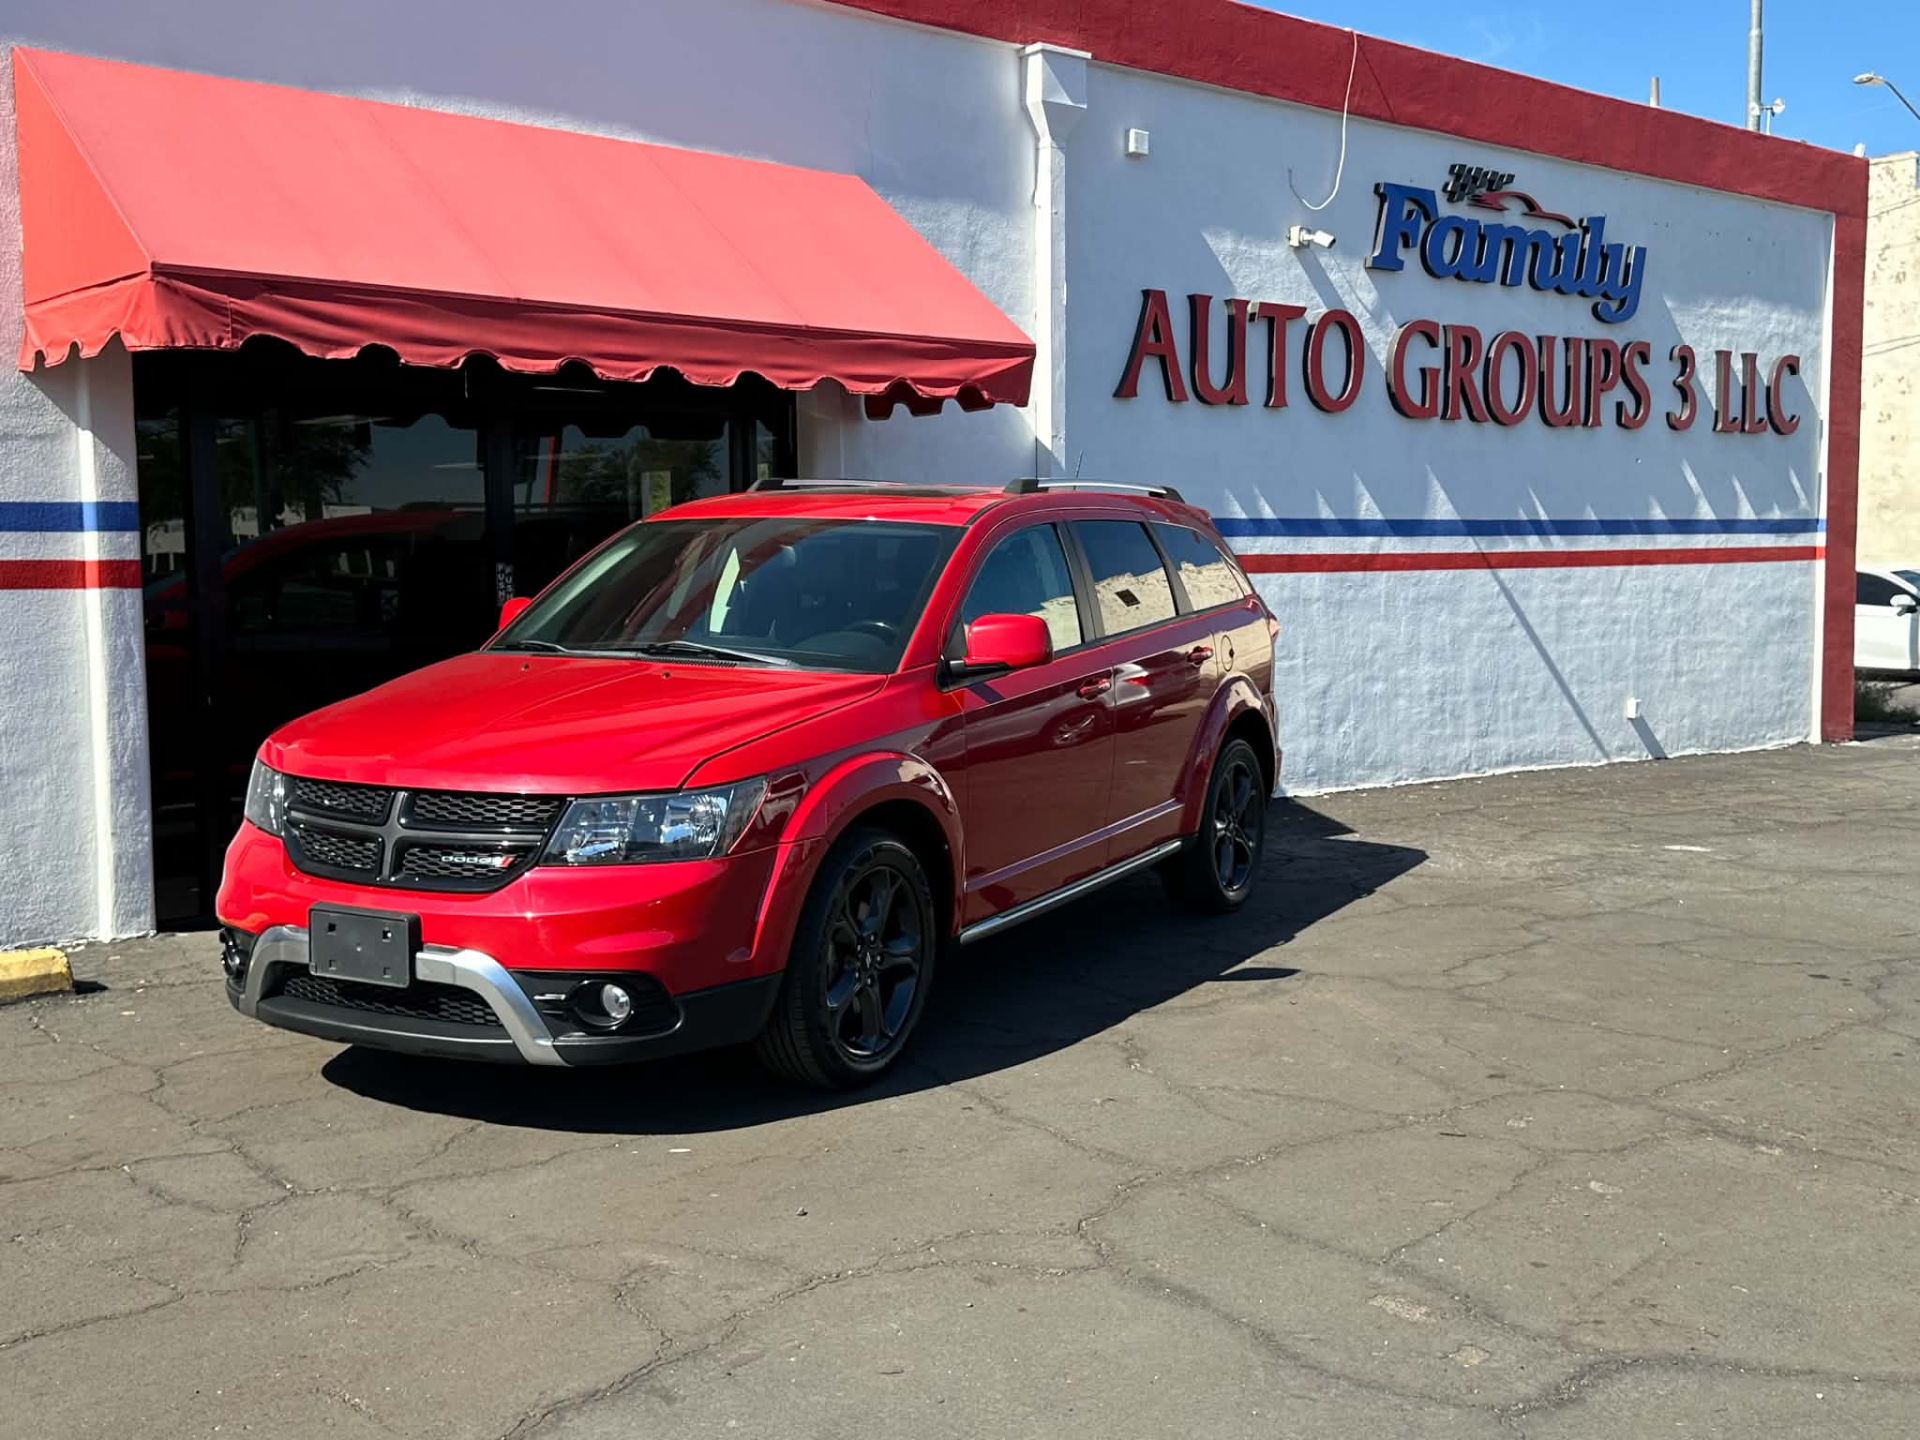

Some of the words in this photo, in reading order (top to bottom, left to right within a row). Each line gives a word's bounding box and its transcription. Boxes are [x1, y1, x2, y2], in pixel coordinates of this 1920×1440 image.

[1366, 182, 1647, 324] Family
[1113, 289, 1365, 413] AUTO
[1386, 319, 1651, 430] GROUPS
[1667, 344, 1696, 432] 3
[1714, 349, 1801, 435] LLC
